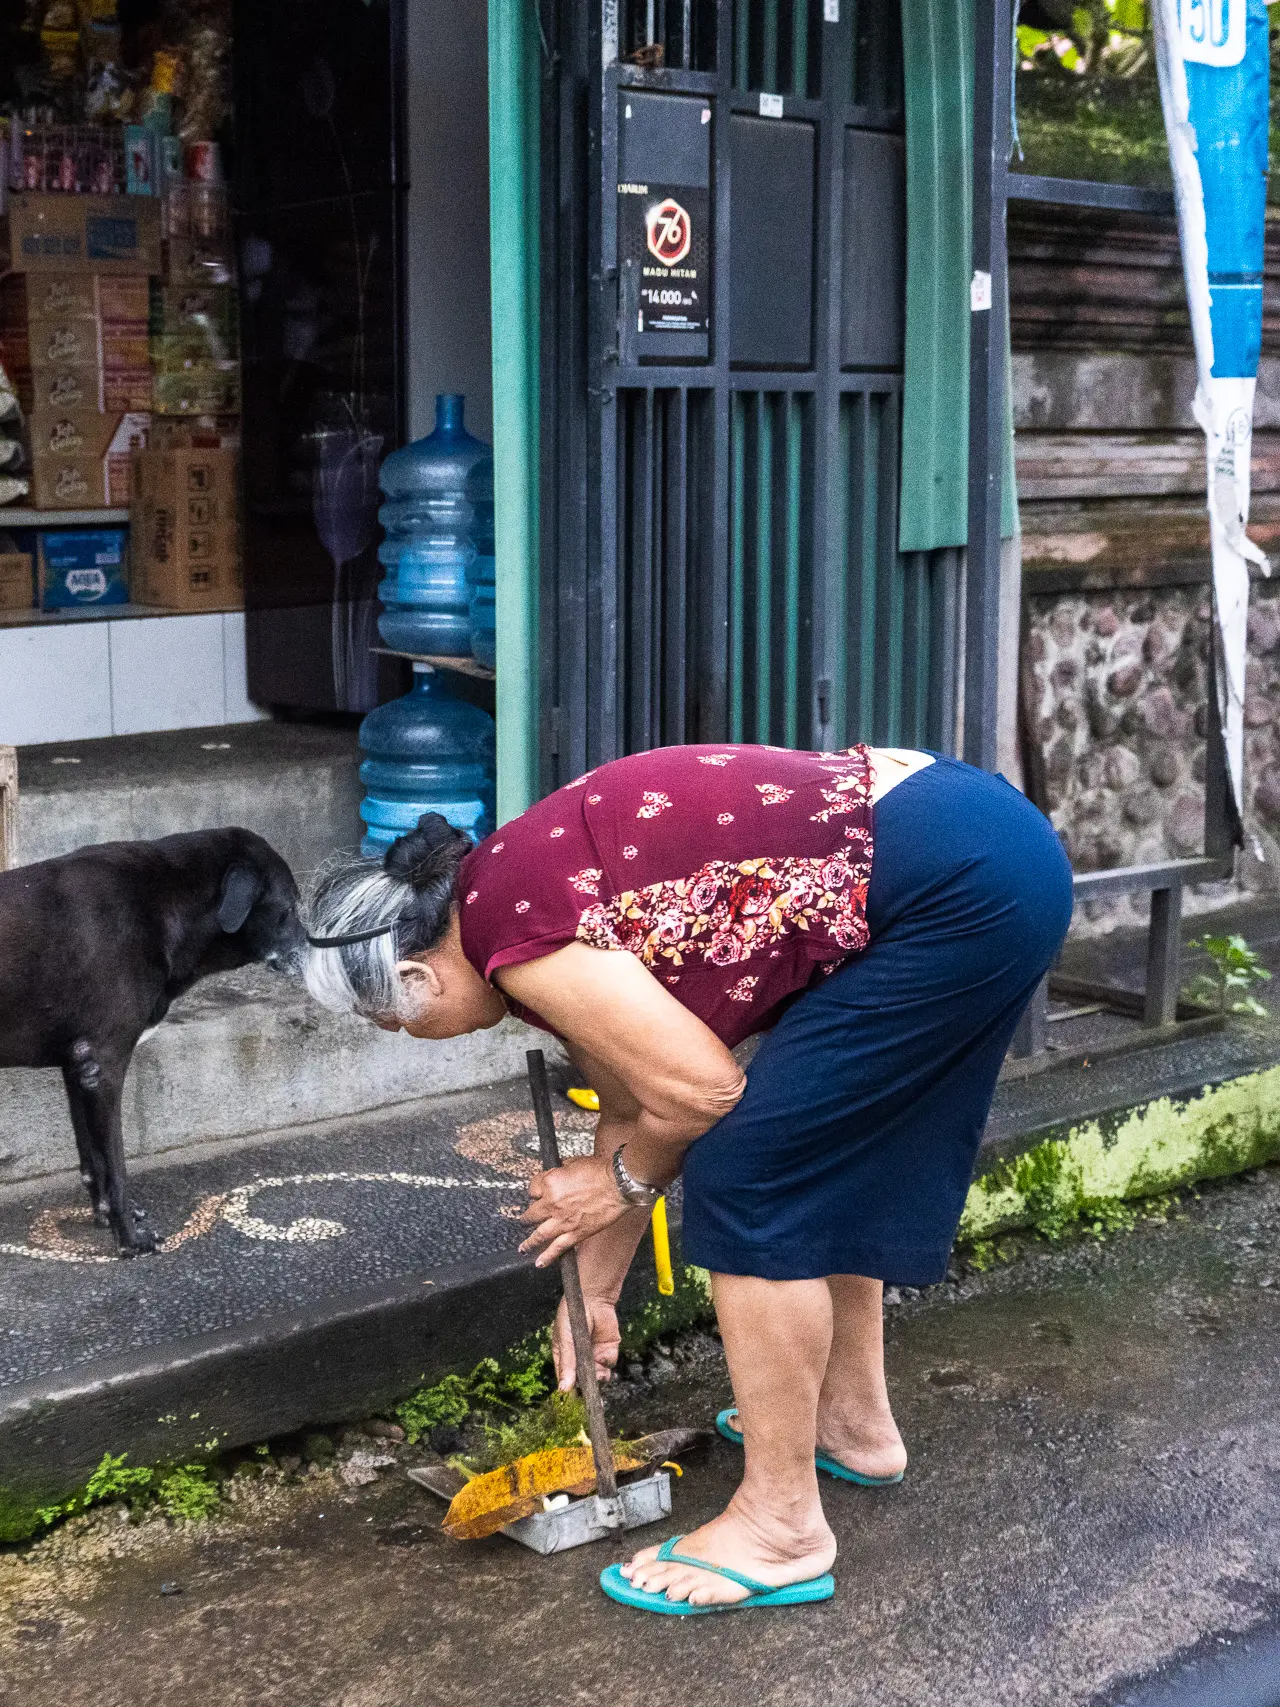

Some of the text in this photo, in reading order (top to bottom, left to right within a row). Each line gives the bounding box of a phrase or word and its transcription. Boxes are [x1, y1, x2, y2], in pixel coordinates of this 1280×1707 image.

[655, 207, 682, 251] 76
[643, 267, 697, 279] MADU HITAM
